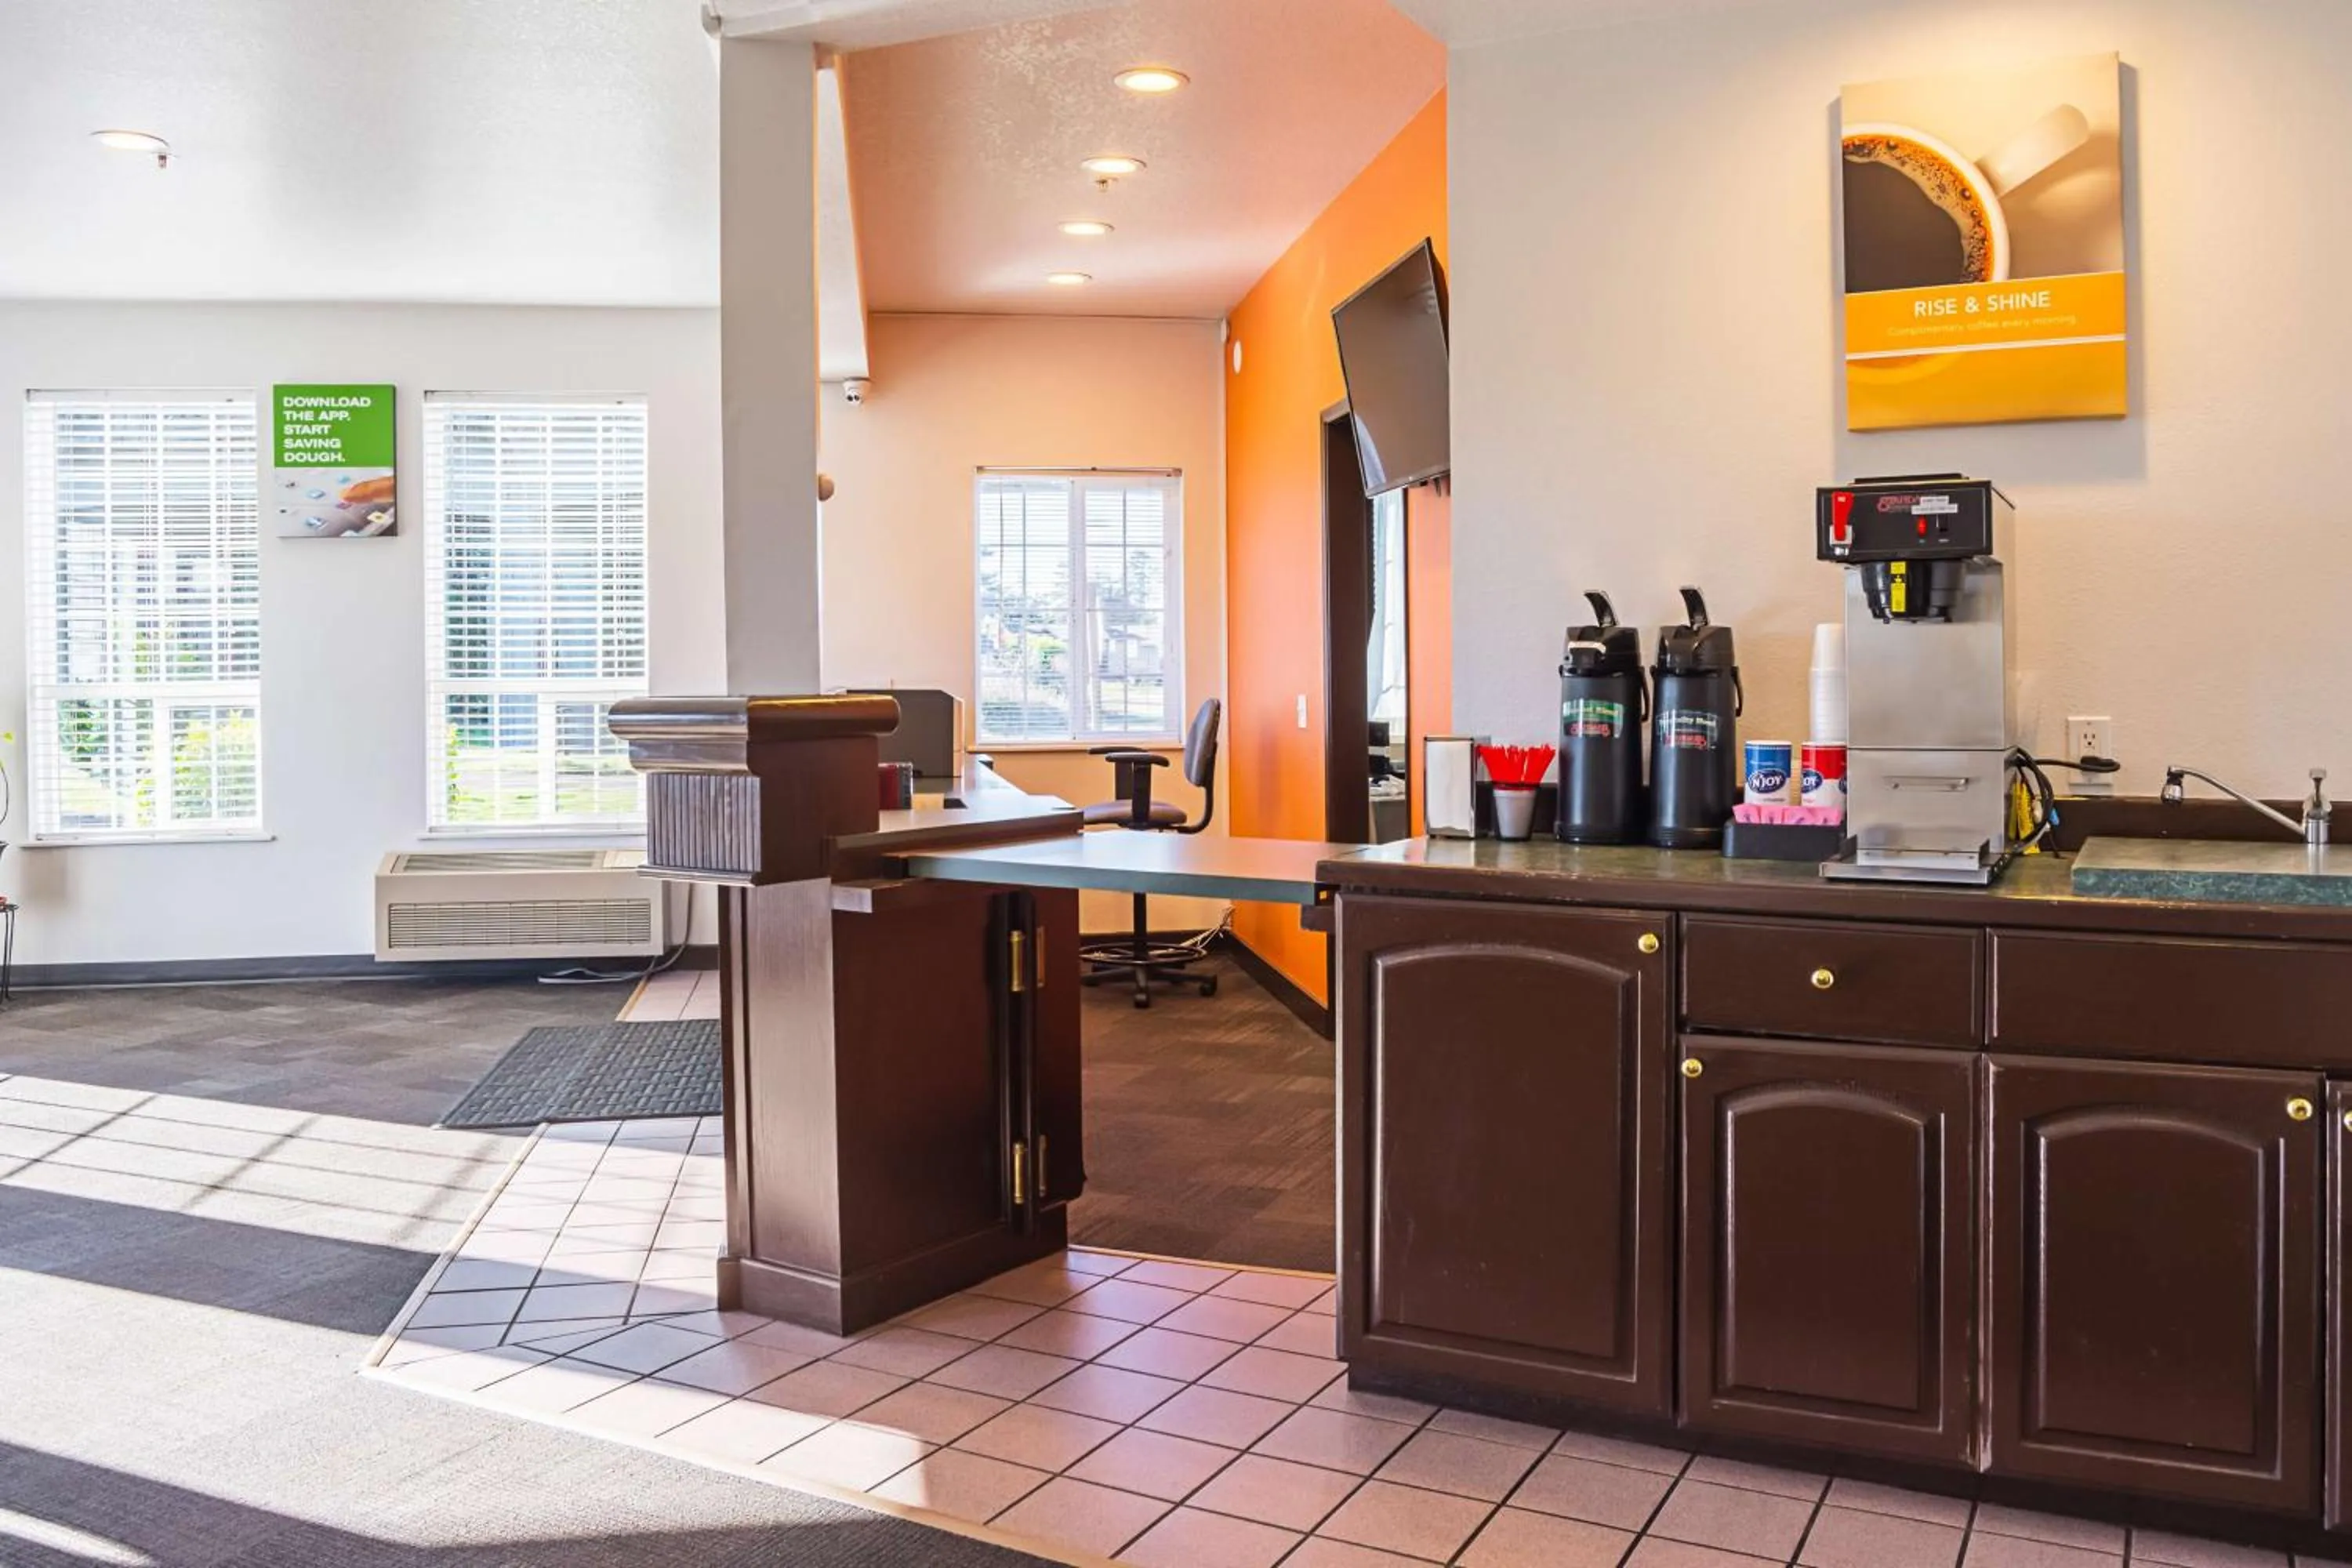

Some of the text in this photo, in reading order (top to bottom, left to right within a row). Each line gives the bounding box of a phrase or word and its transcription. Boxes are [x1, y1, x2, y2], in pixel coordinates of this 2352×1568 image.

[1913, 290, 2052, 318] RISE & SHINE
[283, 396, 372, 408] DOWNLOAD
[283, 410, 351, 422] THE APP.
[283, 424, 332, 435] START
[283, 437, 342, 449] SAVING
[283, 452, 346, 463] DOUGH.
